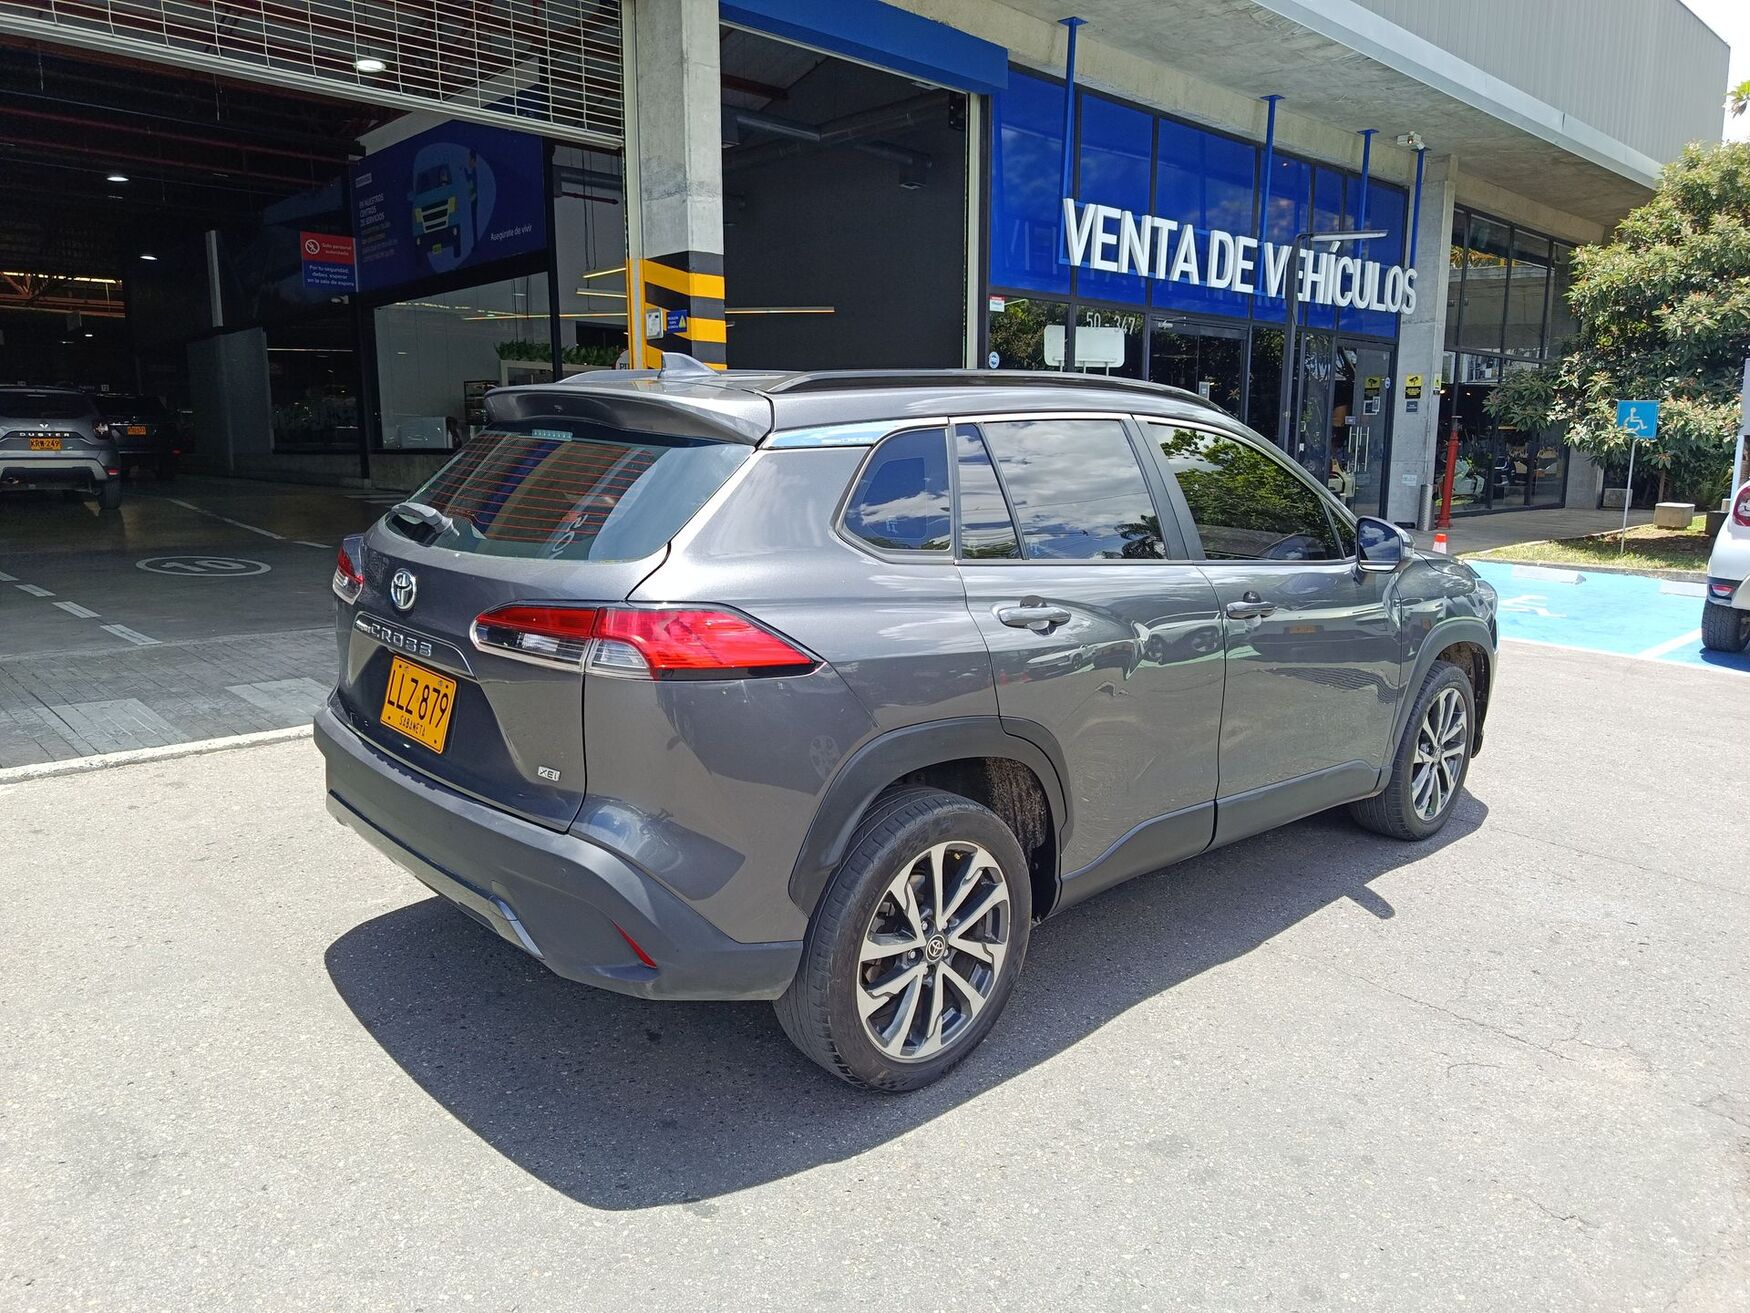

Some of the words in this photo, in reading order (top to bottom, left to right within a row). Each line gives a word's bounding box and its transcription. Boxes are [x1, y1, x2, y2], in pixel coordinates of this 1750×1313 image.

[1063, 198, 1199, 285] VENTA
[1206, 229, 1258, 294] DE
[371, 623, 432, 657] CROSS
[399, 715, 426, 737] SABANETA
